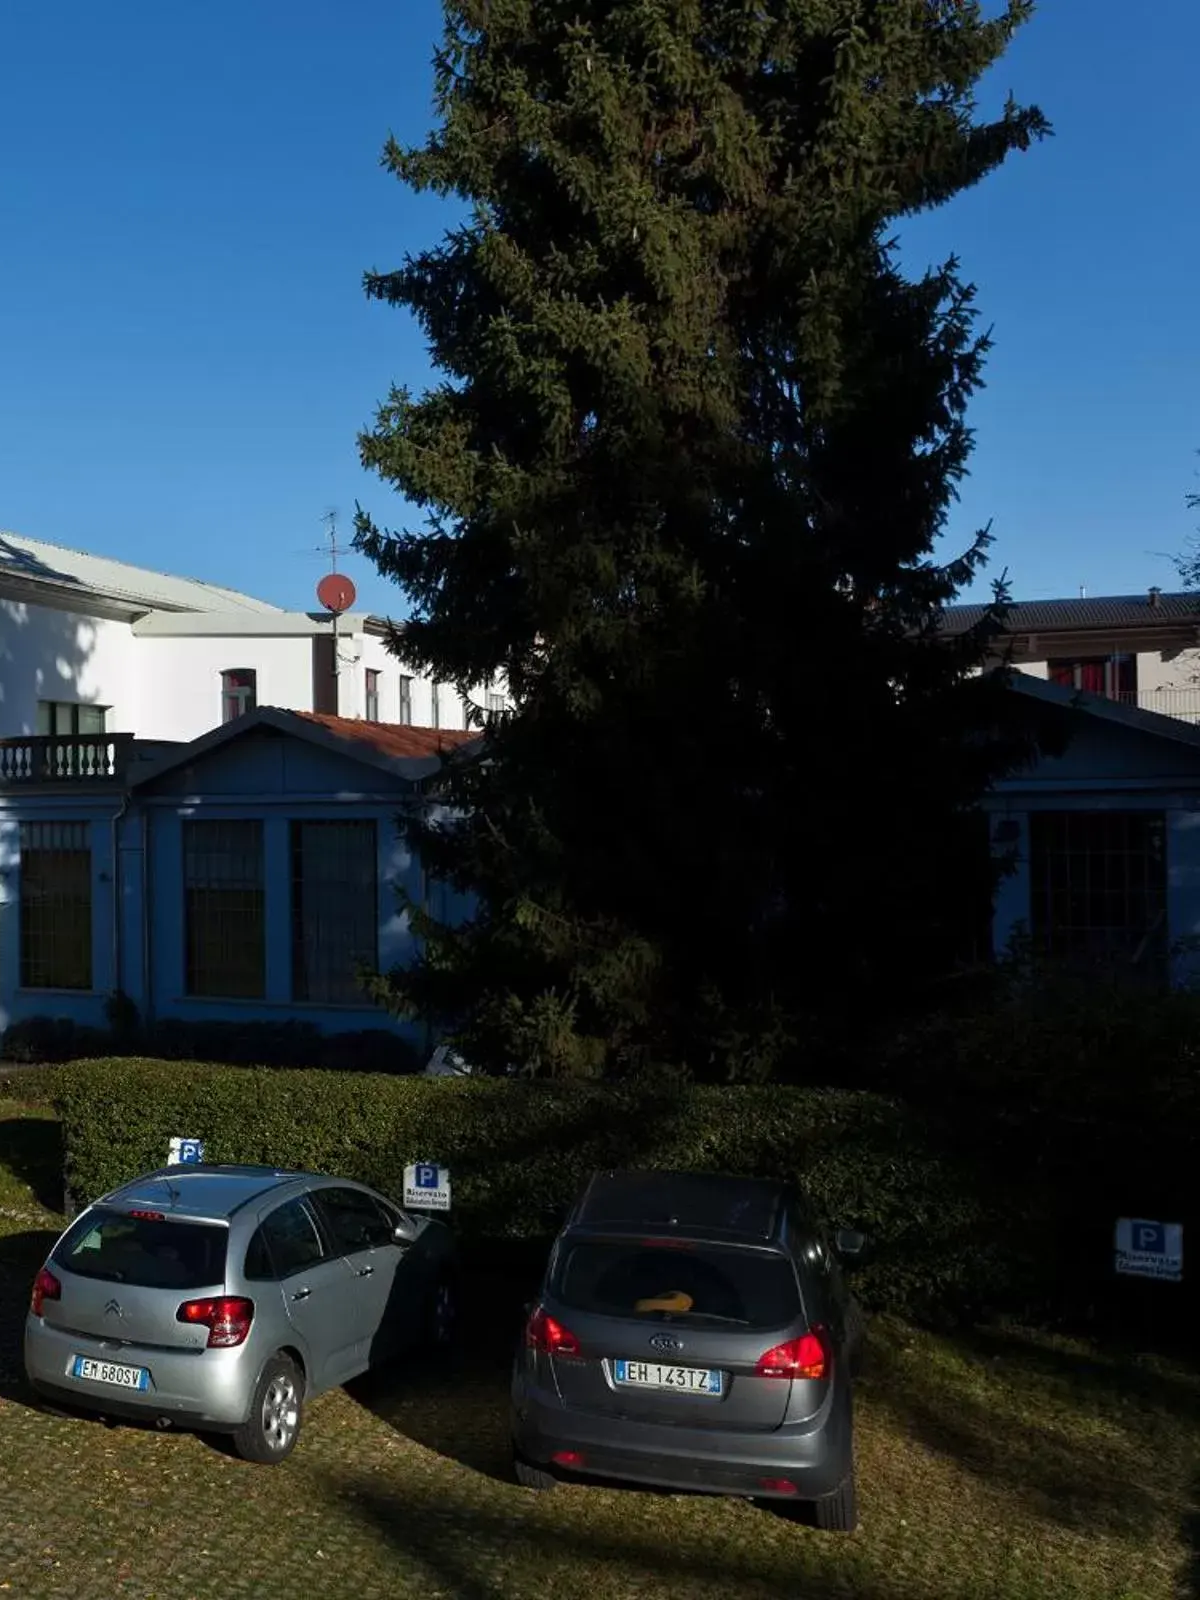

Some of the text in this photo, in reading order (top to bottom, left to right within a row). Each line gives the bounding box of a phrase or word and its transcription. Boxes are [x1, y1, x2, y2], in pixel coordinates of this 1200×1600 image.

[183, 1144, 196, 1161] P
[420, 1168, 433, 1185] P
[1140, 1227, 1158, 1249] P
[82, 1361, 98, 1377] EM
[628, 1363, 708, 1389] EH 143TZ
